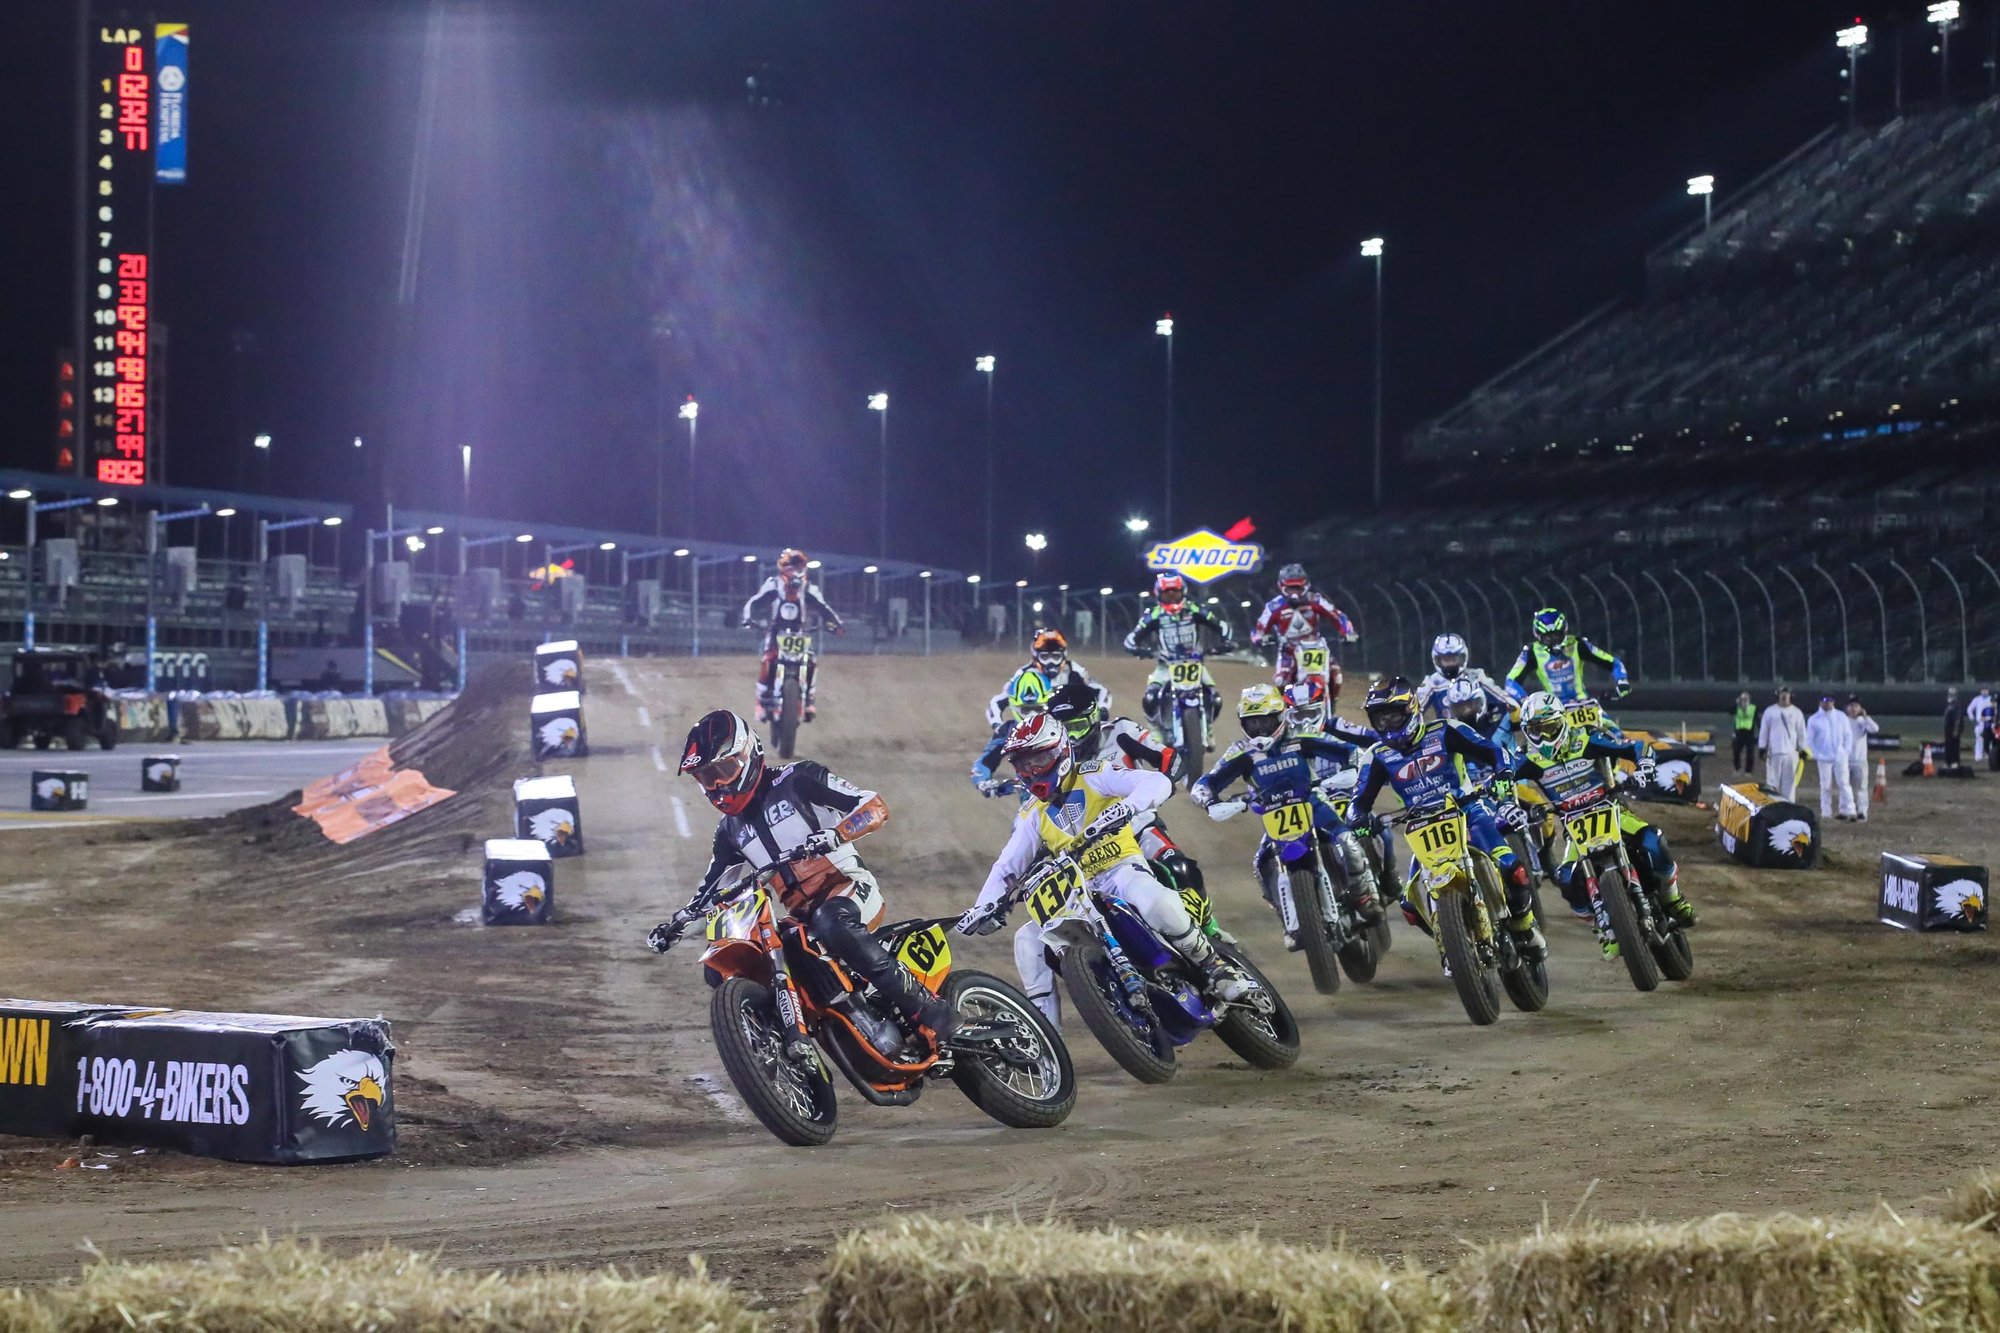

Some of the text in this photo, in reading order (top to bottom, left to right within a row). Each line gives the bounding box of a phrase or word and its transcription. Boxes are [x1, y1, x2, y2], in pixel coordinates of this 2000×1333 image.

[101, 27, 142, 44] LAP
[126, 47, 142, 71] 0
[102, 78, 111, 93] 1
[100, 103, 113, 119] 2
[100, 129, 113, 145] 3
[99, 155, 113, 170] 4
[99, 180, 113, 196] 5
[99, 206, 113, 222] 6
[99, 232, 112, 247] 7
[98, 257, 113, 274] 8
[98, 283, 112, 299] 9
[94, 309, 117, 325] 10
[93, 335, 114, 351] 11
[93, 361, 116, 376] 12
[93, 387, 115, 403] 13
[1152, 547, 1255, 566] SUNOCO
[783, 636, 805, 653] 99
[1302, 651, 1324, 667] 94
[1173, 663, 1199, 683] 98
[1570, 709, 1596, 725] 185
[1257, 757, 1299, 776] Haith
[1404, 774, 1444, 794] medAge
[1274, 805, 1303, 836] 24
[1573, 810, 1612, 845] 377
[1419, 822, 1457, 852] 116
[1088, 841, 1121, 864] BEND
[1031, 869, 1083, 927] 132
[907, 930, 946, 972] 62
[780, 990, 793, 1027] EVANS
[0, 1017, 50, 1086] WN
[77, 1056, 250, 1125] 1-800-4-BIKERS
